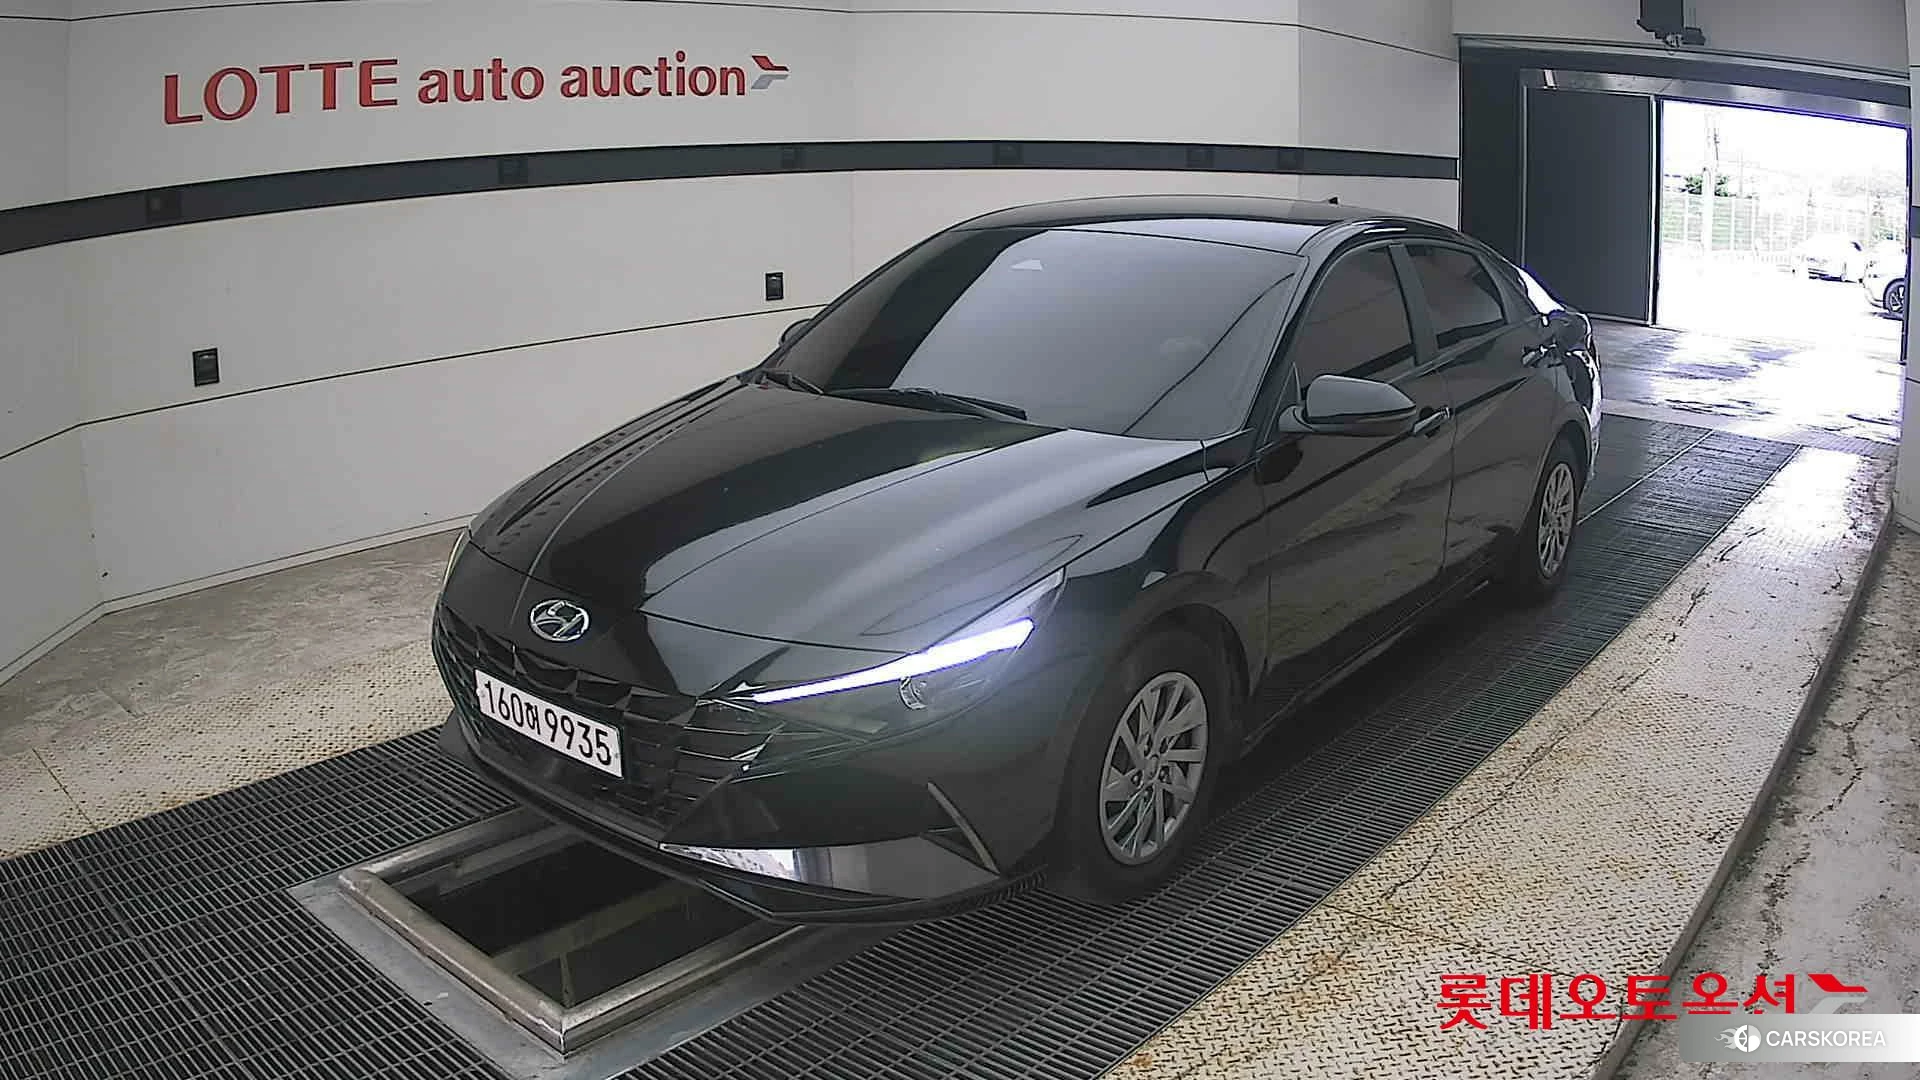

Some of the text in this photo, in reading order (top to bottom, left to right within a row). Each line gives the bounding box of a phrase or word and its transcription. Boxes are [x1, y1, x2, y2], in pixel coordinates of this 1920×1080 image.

[164, 51, 746, 125] LOTTE auto auction
